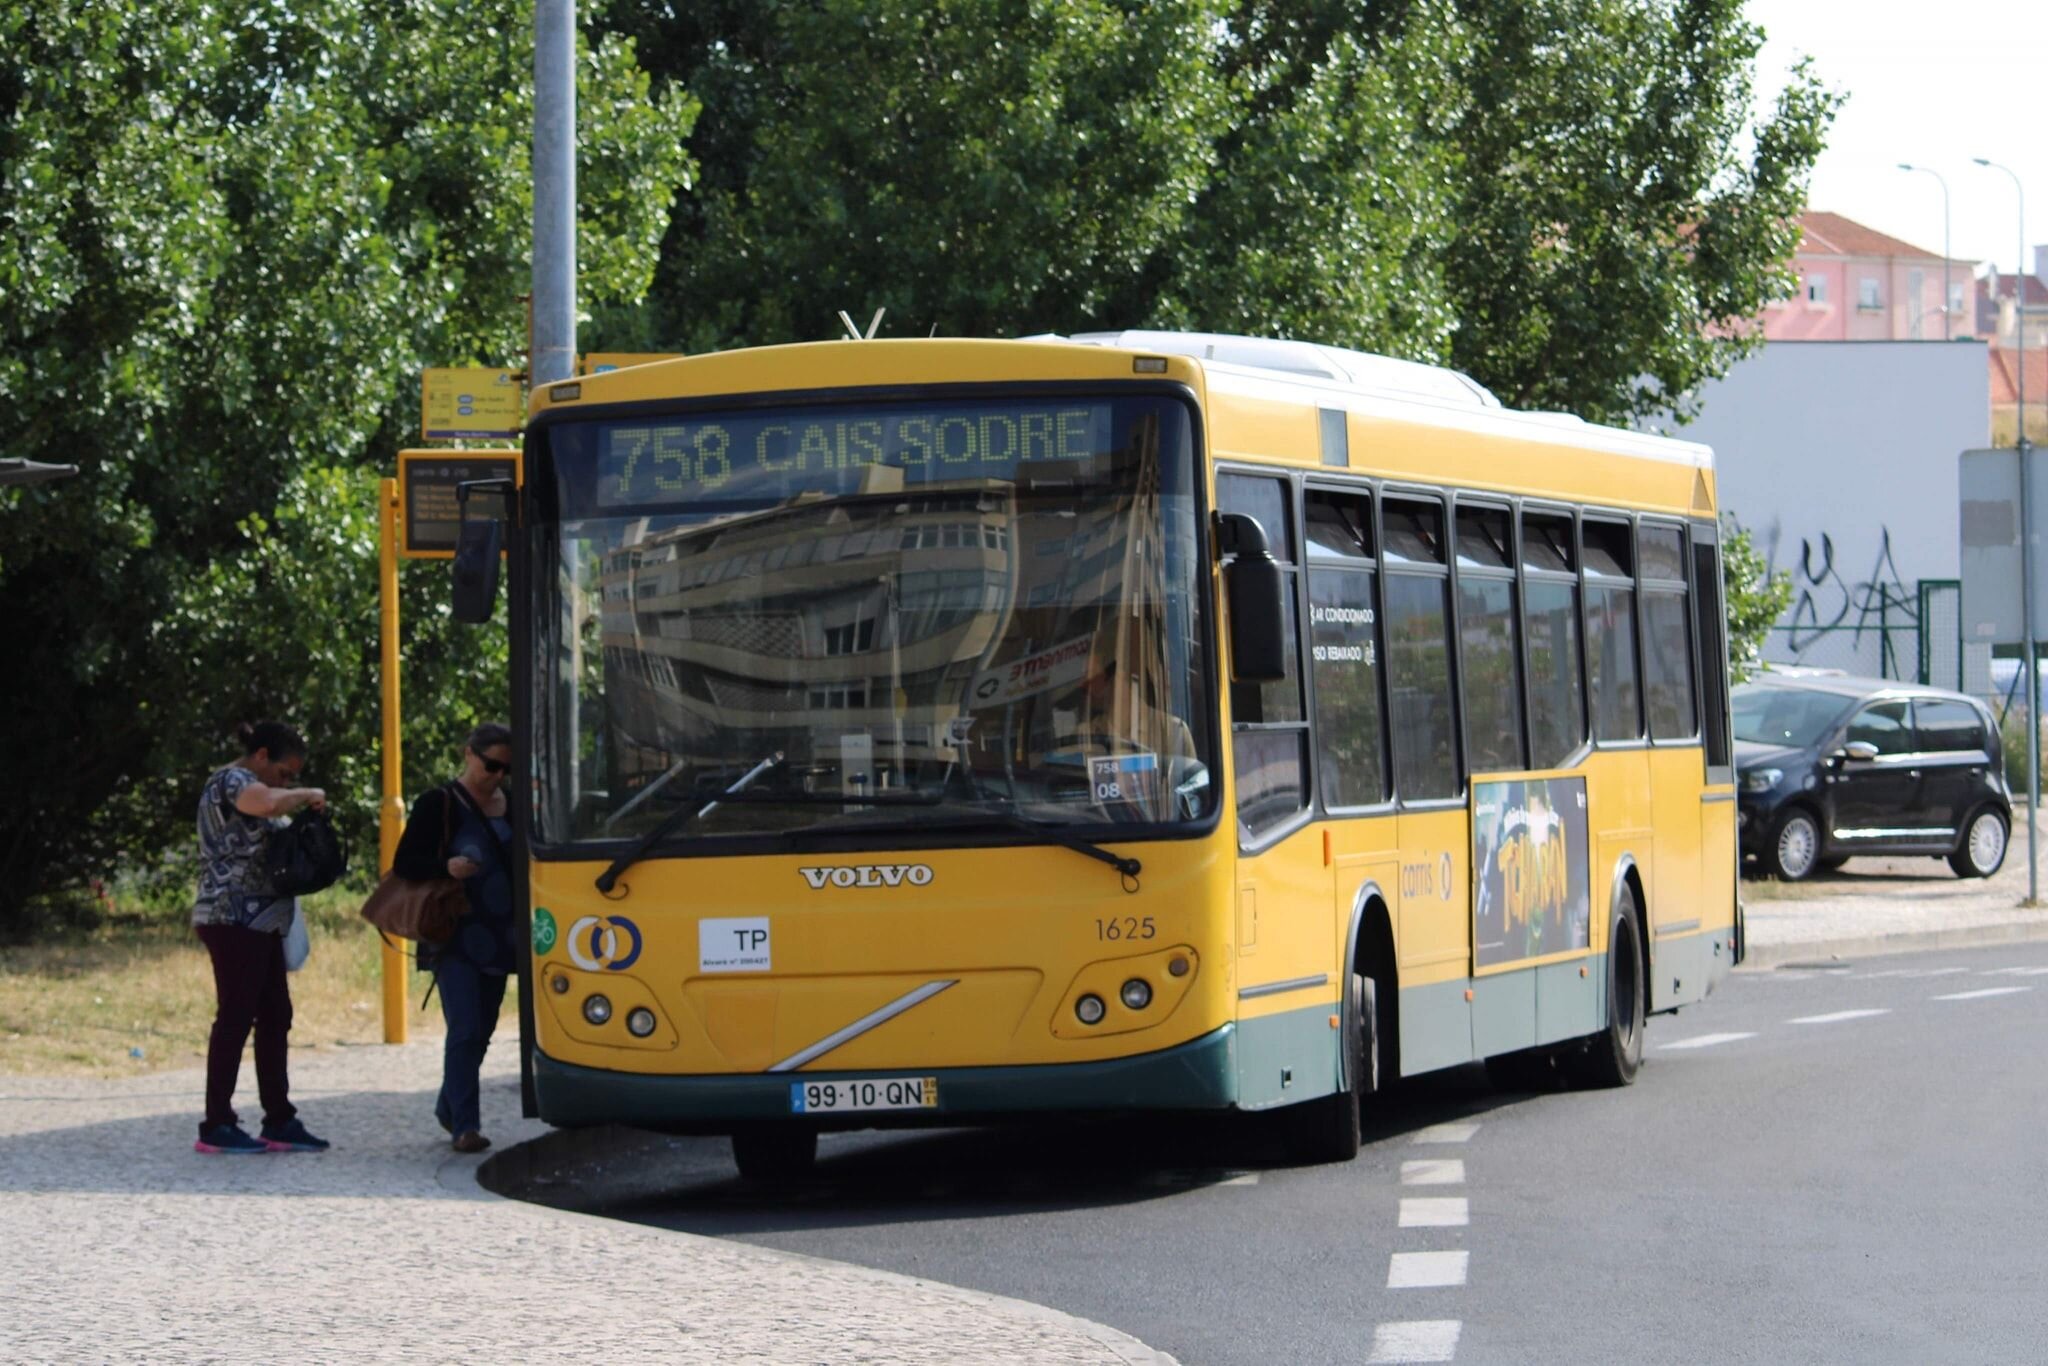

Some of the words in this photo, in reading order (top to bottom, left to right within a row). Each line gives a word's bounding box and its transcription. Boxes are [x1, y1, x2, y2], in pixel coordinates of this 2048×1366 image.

[611, 425, 731, 491] 758
[756, 421, 882, 471] CAIS
[900, 411, 1090, 465] SODRE
[1316, 608, 1324, 621] AR
[1096, 762, 1119, 774] 758
[1097, 783, 1120, 798] 08
[798, 864, 933, 890] VOLVO
[733, 929, 767, 951] TP
[1096, 917, 1156, 941] 1625
